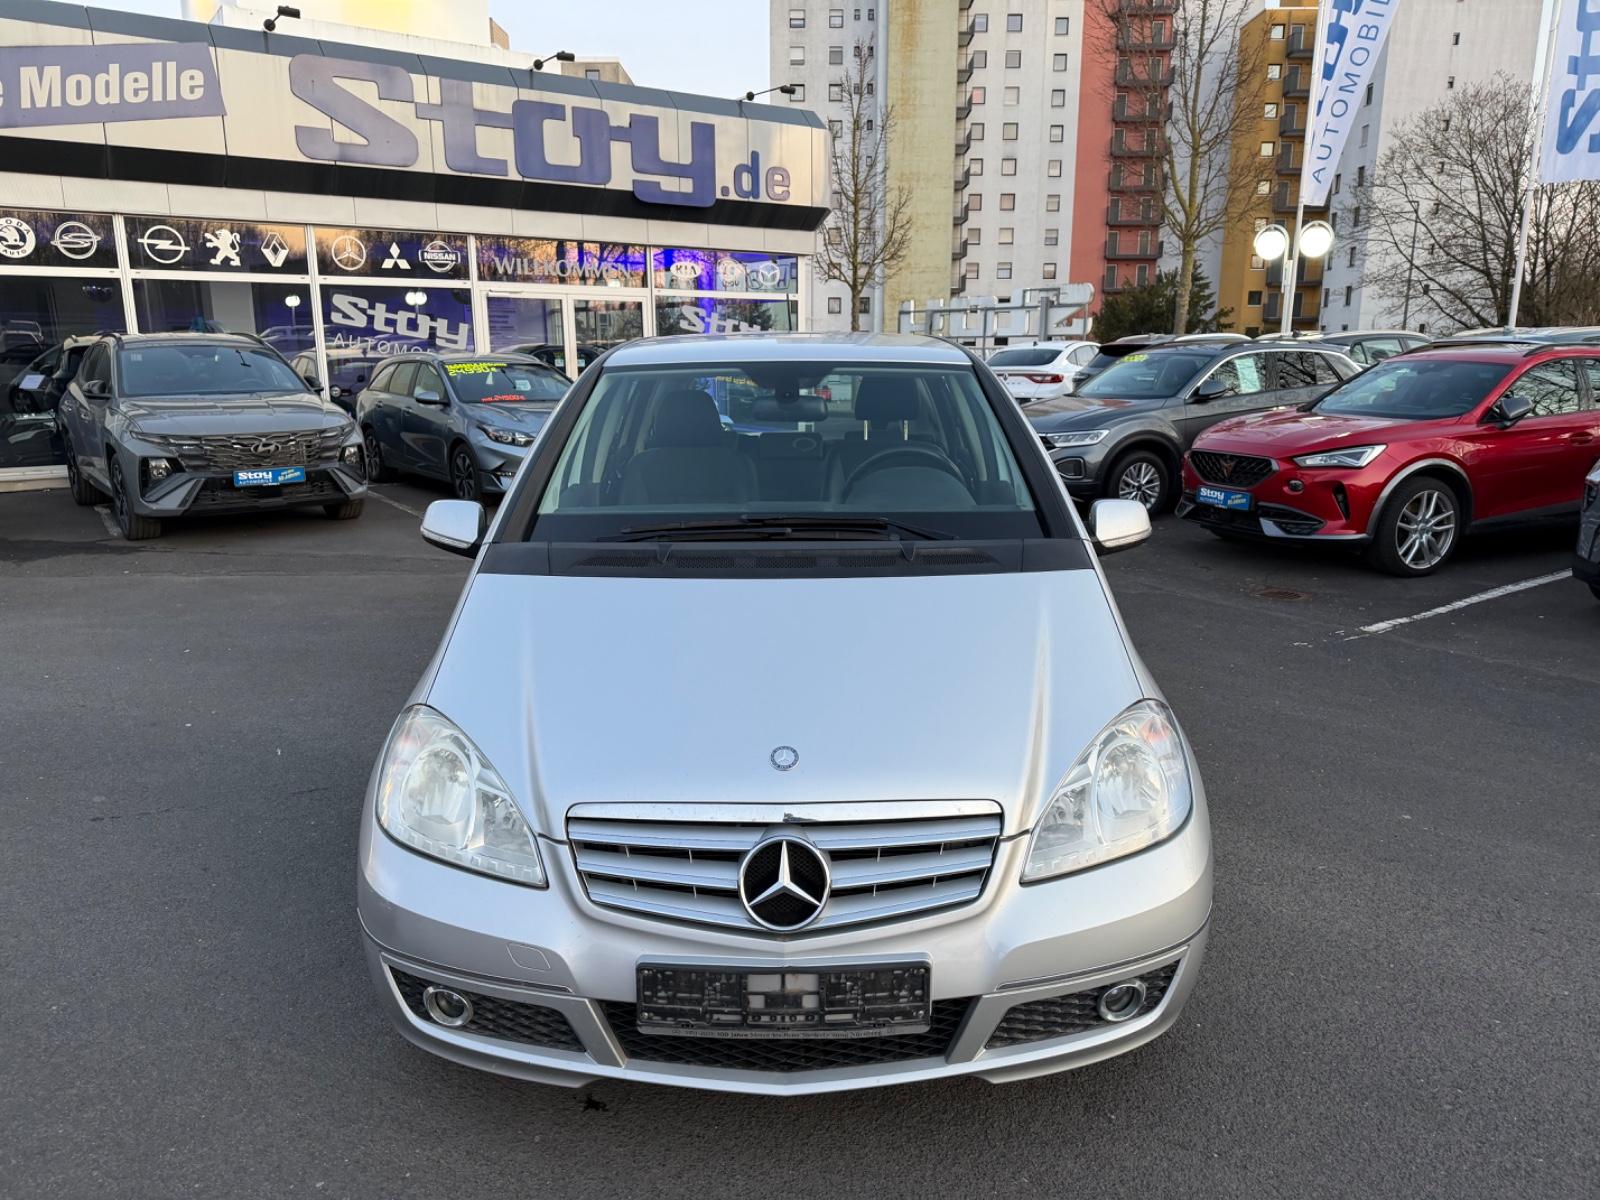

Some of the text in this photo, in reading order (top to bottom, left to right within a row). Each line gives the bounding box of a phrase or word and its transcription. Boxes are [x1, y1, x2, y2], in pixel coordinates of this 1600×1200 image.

[19, 61, 205, 109] Modelle
[423, 252, 457, 261] NISSAN
[493, 256, 633, 280] WILLKOMMEN
[330, 294, 469, 350] Stoy
[238, 471, 272, 480] Stoy
[1200, 487, 1225, 501] Stoy
